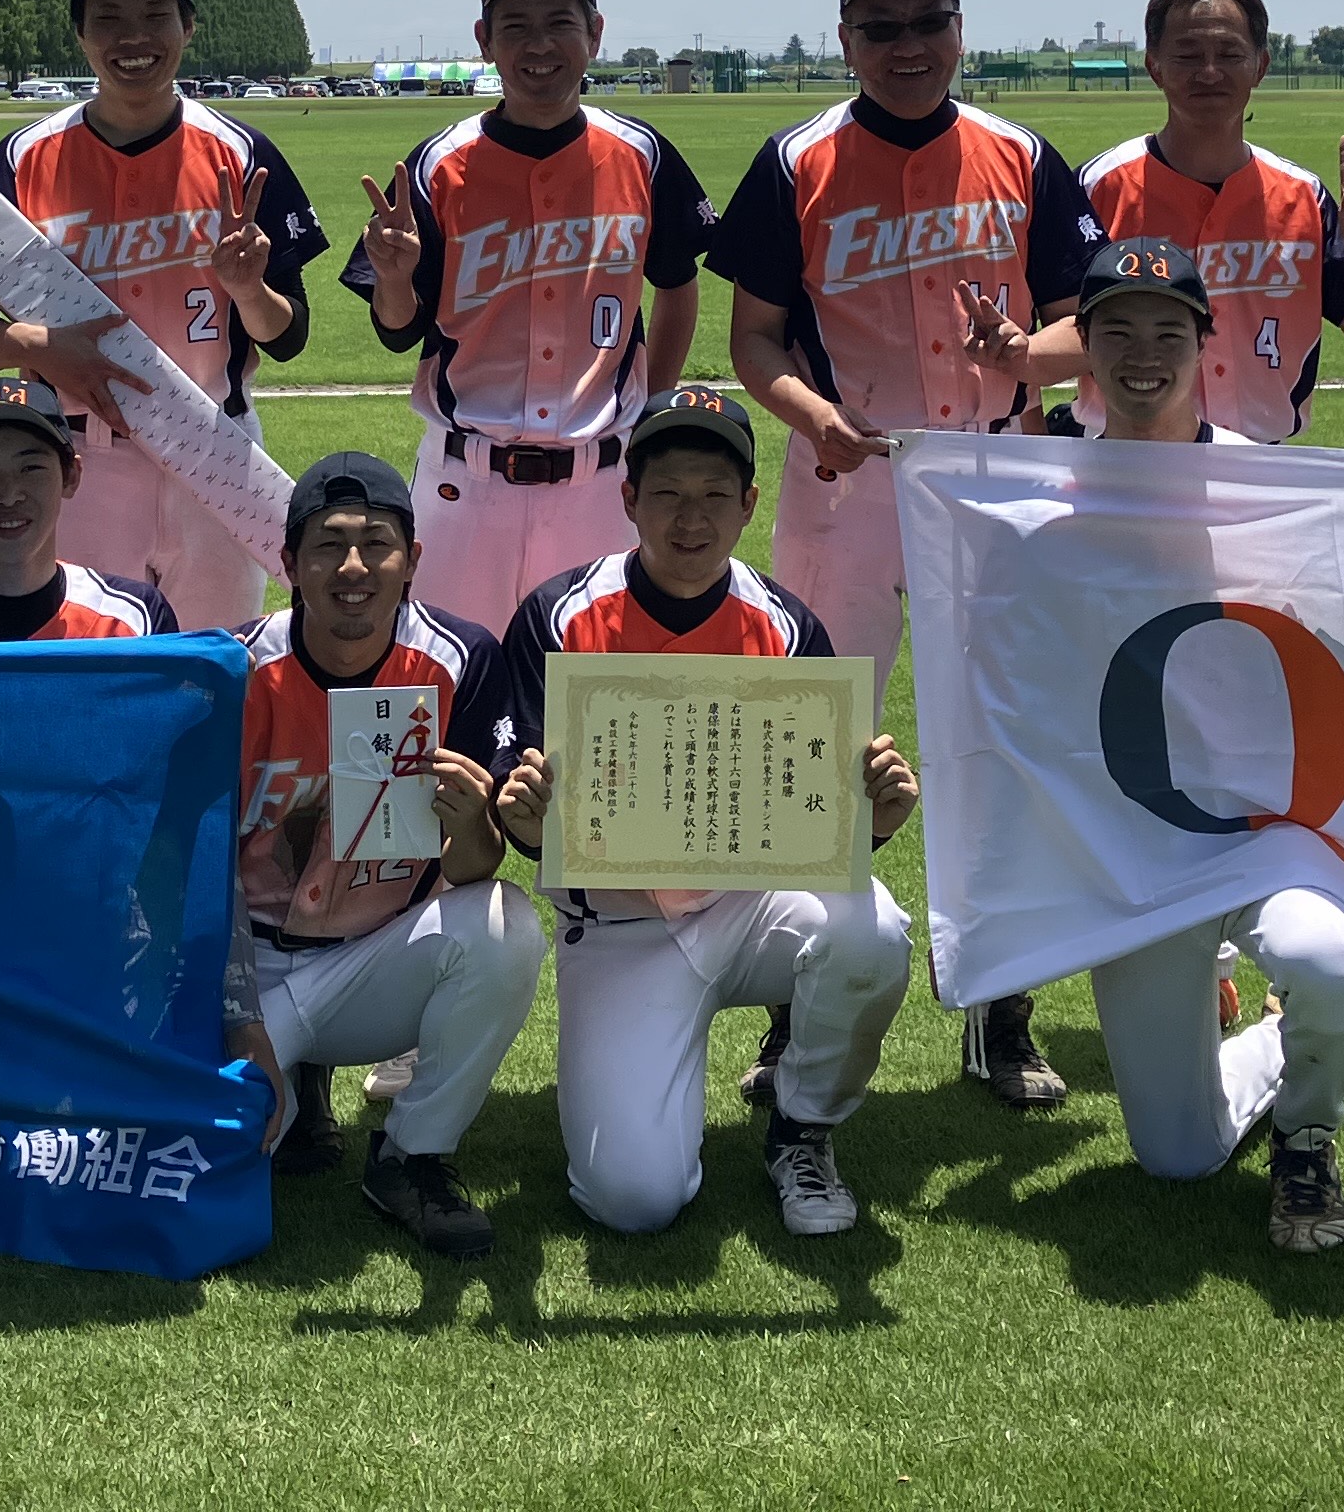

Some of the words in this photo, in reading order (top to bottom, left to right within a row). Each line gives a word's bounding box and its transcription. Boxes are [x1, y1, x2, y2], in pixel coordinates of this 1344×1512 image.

[453, 214, 647, 315] ENESYS
[820, 199, 1028, 296] ENESYS
[1115, 252, 1171, 280] Q'd
[185, 287, 219, 343] 2
[591, 294, 622, 350] 0
[1255, 317, 1281, 369] 4
[493, 715, 517, 751] 東
